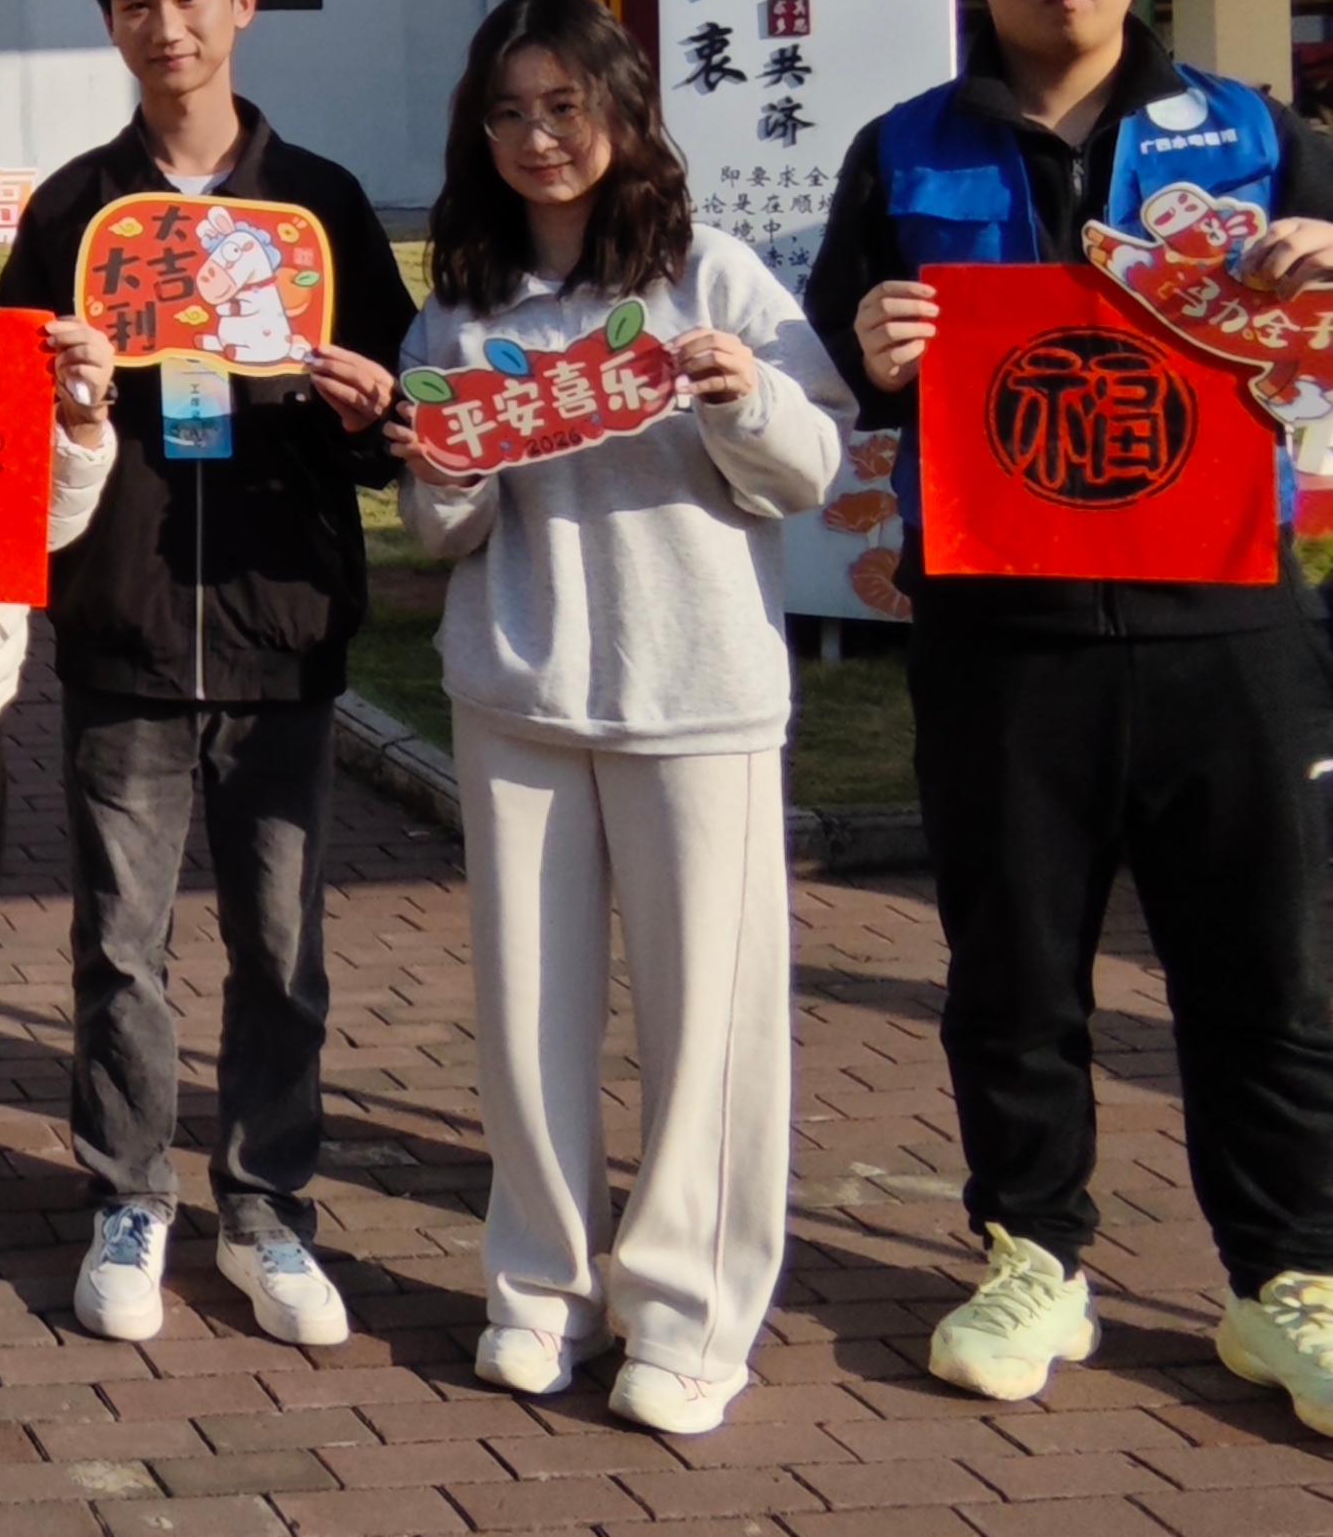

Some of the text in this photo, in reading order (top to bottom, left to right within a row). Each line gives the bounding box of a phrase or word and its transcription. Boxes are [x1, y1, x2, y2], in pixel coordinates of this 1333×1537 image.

[756, 44, 816, 146] 共济
[441, 350, 660, 459] 平安喜乐
[526, 429, 583, 458] 2026
[1007, 345, 1168, 492] 福
